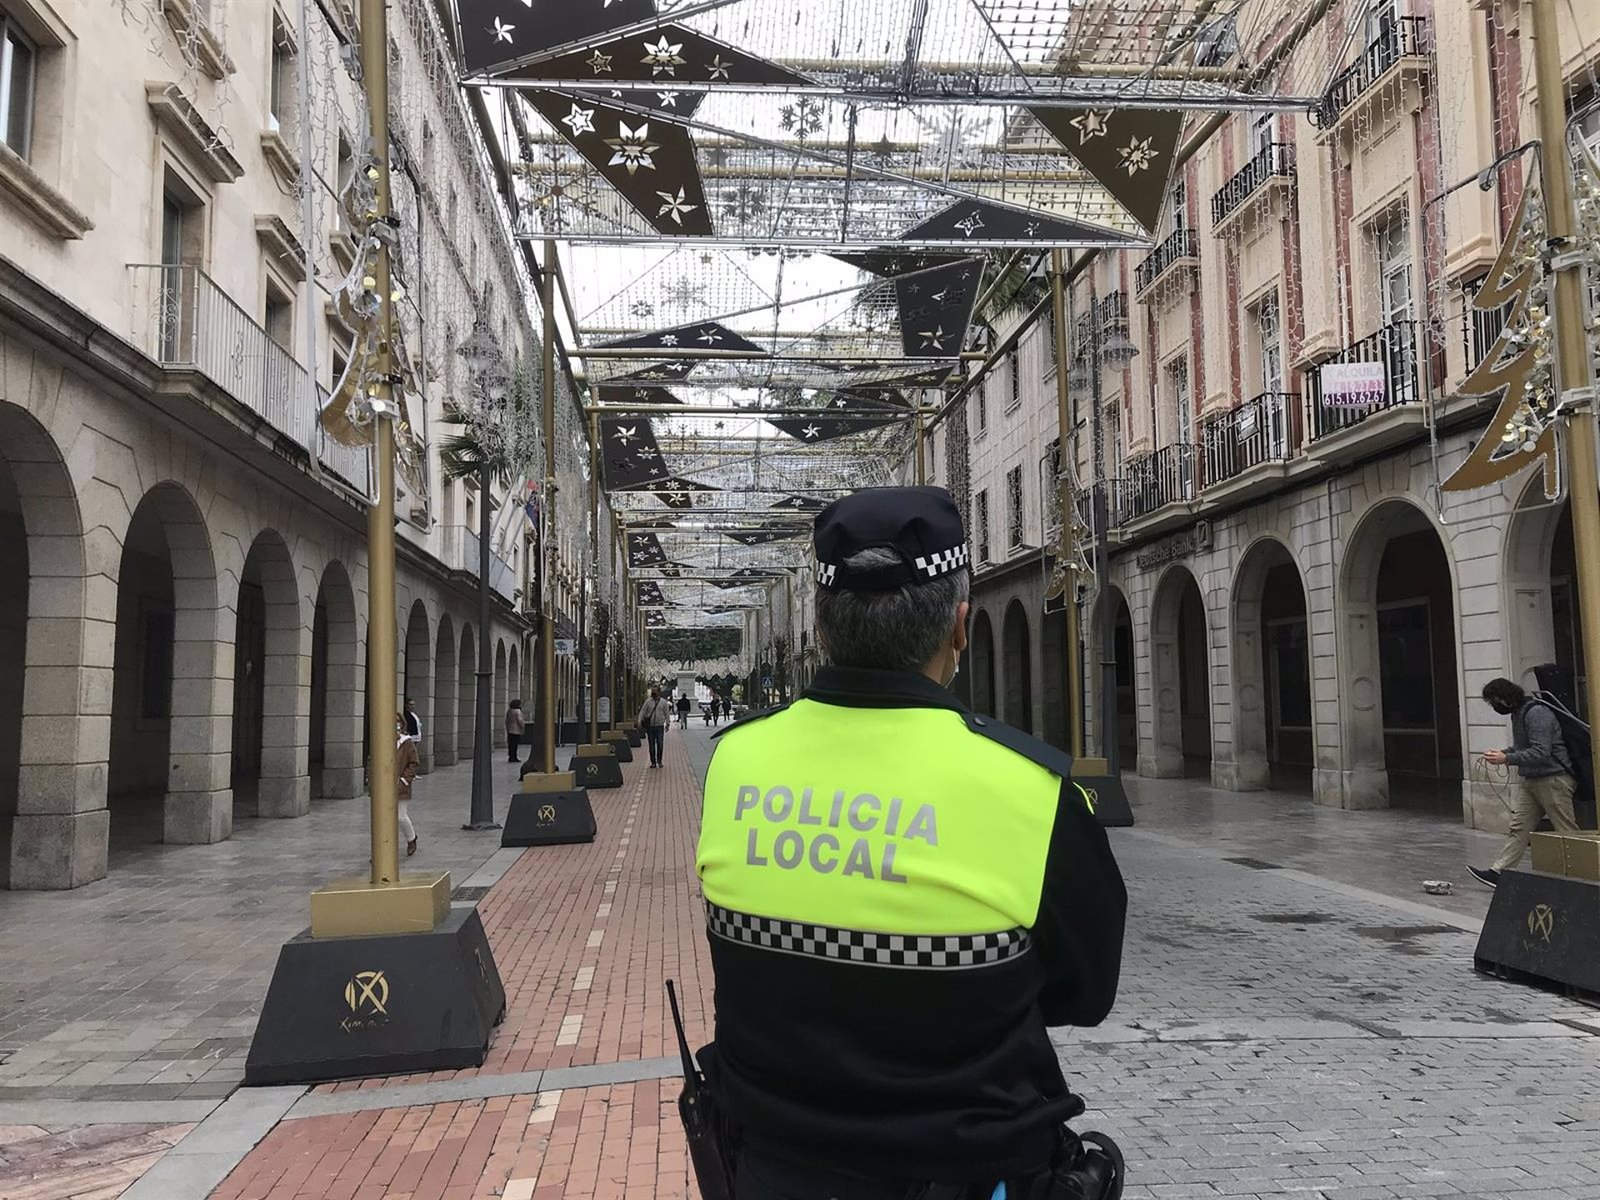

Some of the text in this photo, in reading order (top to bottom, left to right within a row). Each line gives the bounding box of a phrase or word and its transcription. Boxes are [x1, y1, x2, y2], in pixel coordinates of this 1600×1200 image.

[1337, 366, 1384, 378] ALQUILA
[1324, 391, 1385, 406] 615.19.62.67
[1171, 536, 1192, 556] Bank
[734, 785, 938, 846] POLICIA
[746, 828, 908, 884] LOCAL
